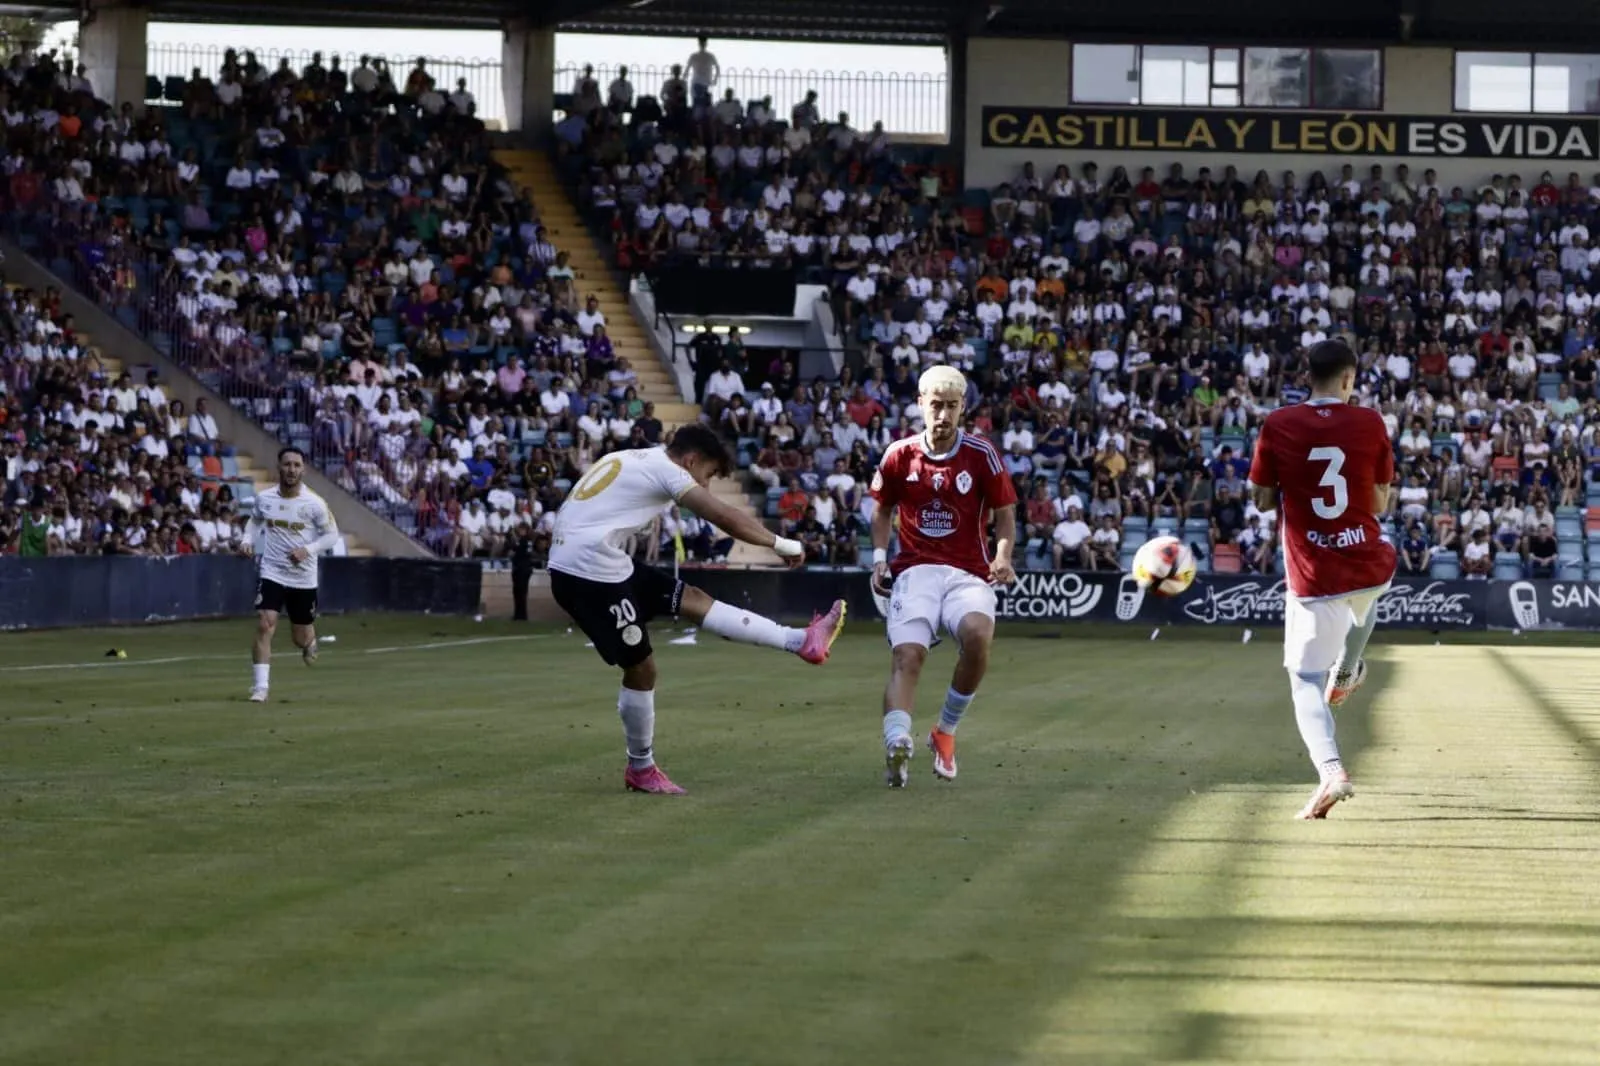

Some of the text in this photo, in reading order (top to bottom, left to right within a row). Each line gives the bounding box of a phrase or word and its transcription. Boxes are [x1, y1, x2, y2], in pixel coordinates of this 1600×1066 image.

[988, 113, 1593, 157] CASTILLA Y LEÓN ES VIDA
[1307, 446, 1348, 520] 3
[992, 573, 1083, 597] XIMO
[609, 598, 637, 629] 20
[995, 598, 1068, 617] ECOM
